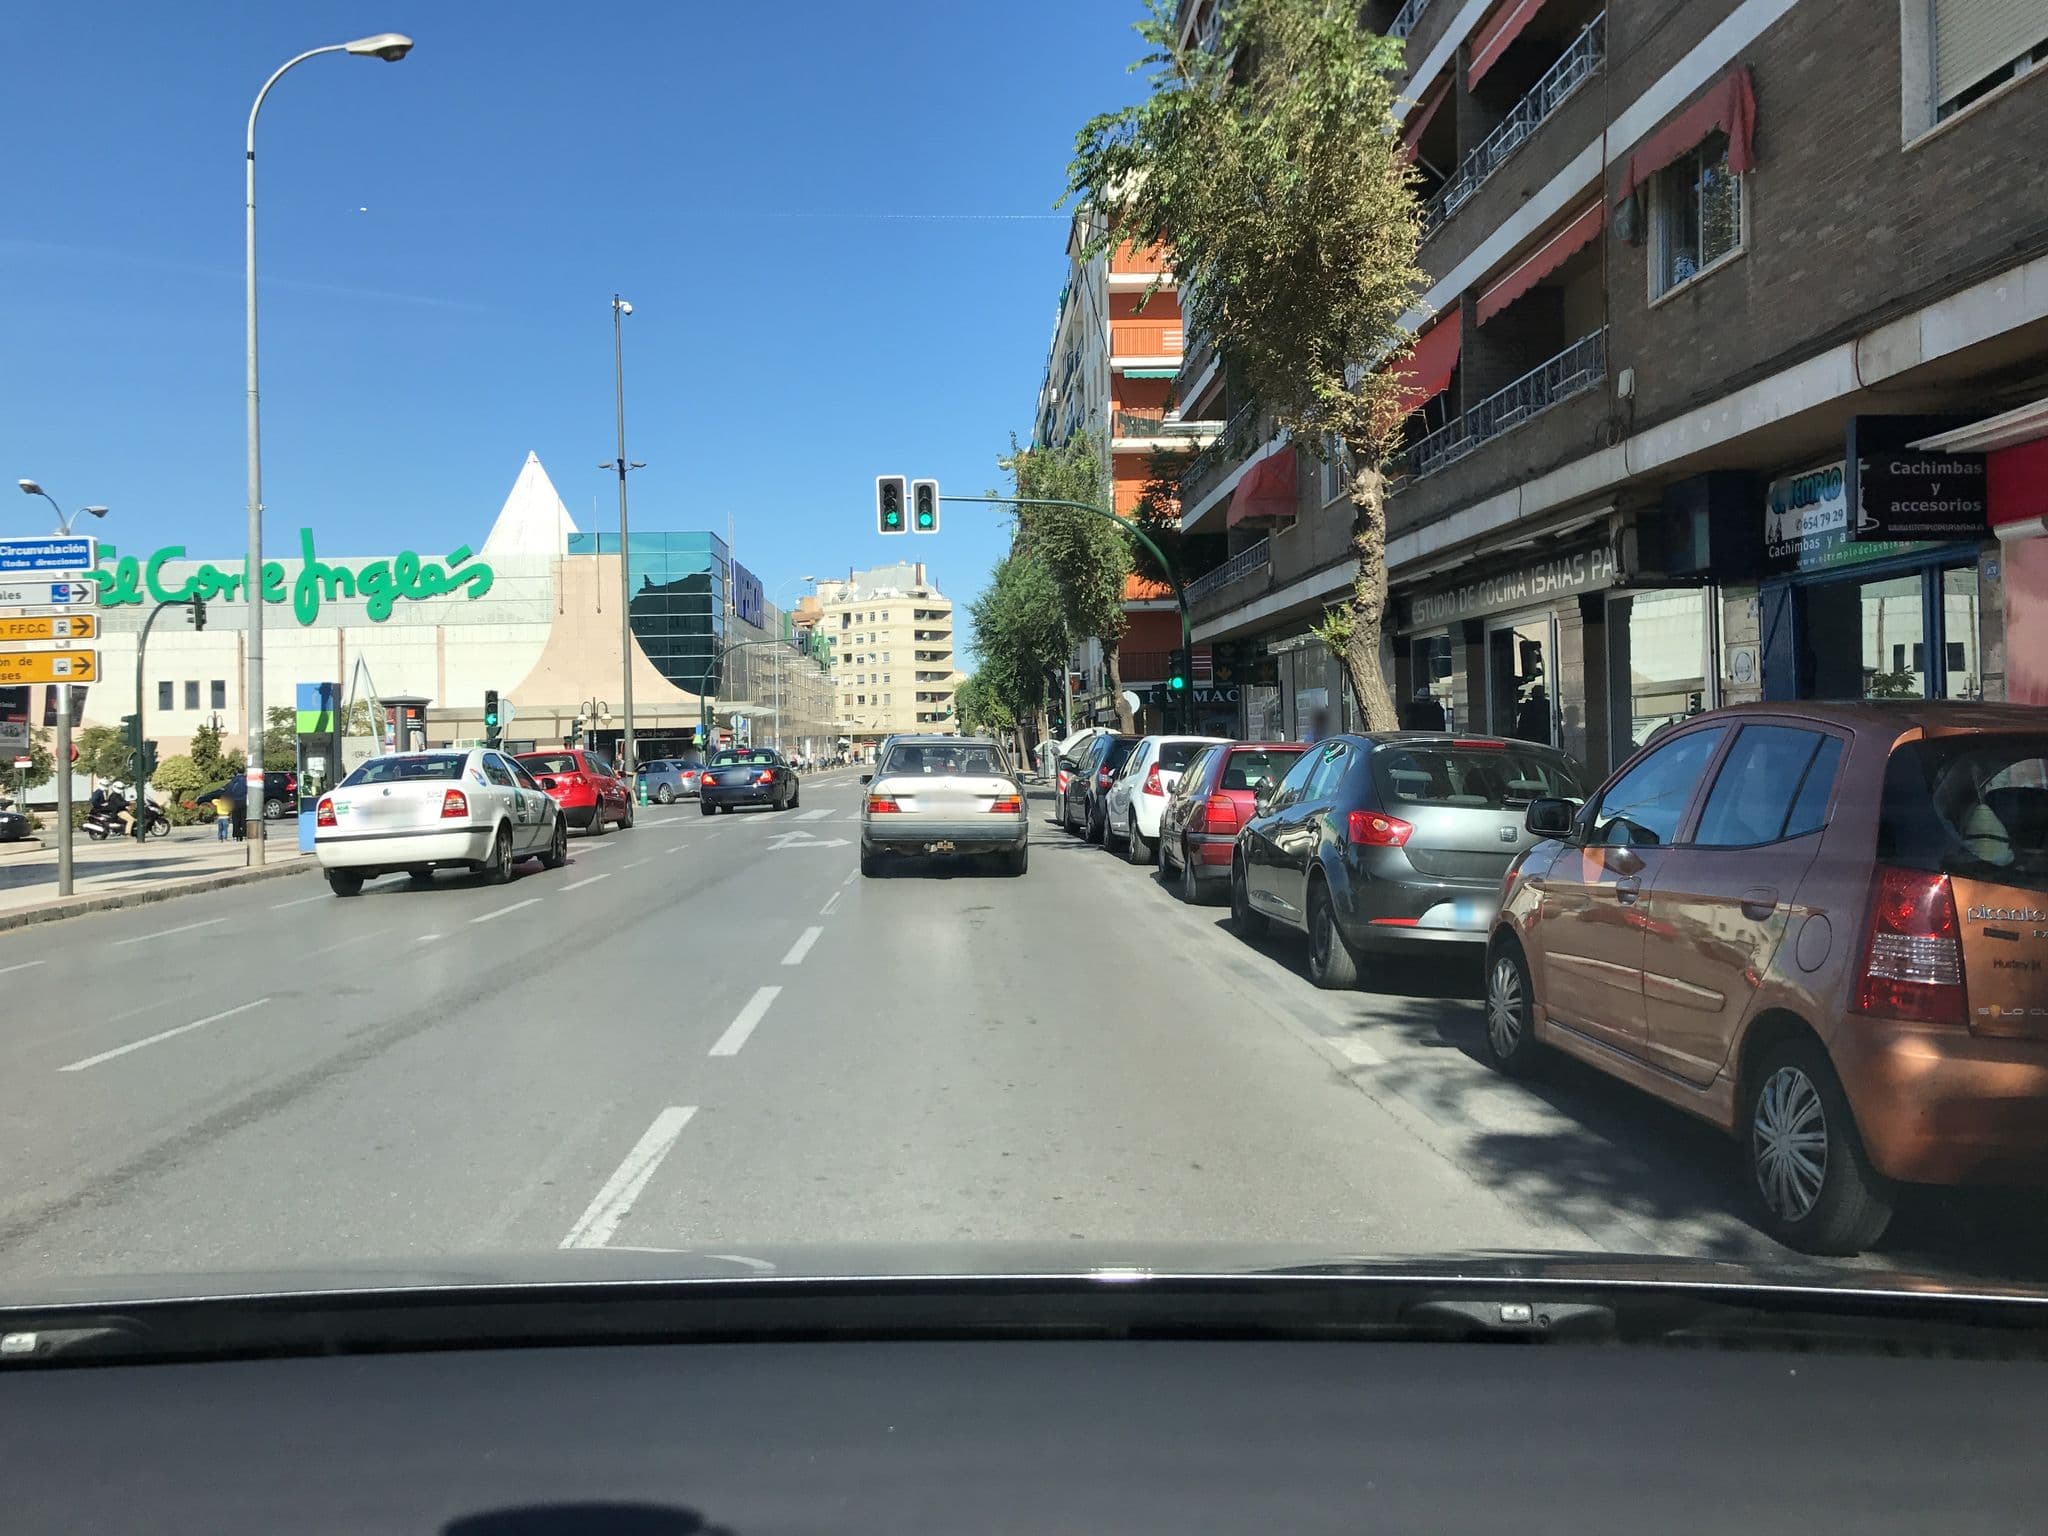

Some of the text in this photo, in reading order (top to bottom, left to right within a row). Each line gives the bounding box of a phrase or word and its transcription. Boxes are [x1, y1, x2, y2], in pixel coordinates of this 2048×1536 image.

[1889, 461, 1983, 475] Cachimbas
[1930, 482, 1941, 496] y
[1890, 499, 1982, 513] accesorios
[0, 544, 87, 556] Circunvalación
[1768, 538, 1820, 558] Cachimbas
[1826, 535, 1833, 550] y
[146, 545, 287, 604] Corte
[293, 527, 495, 626] Inglés
[1411, 590, 1457, 625] ESTUDIO
[1459, 584, 1476, 613] DE
[1478, 571, 1526, 609] COCINA
[1531, 553, 1585, 595] ISAIAS
[18, 657, 33, 666] de
[1967, 904, 2047, 924] picanto
